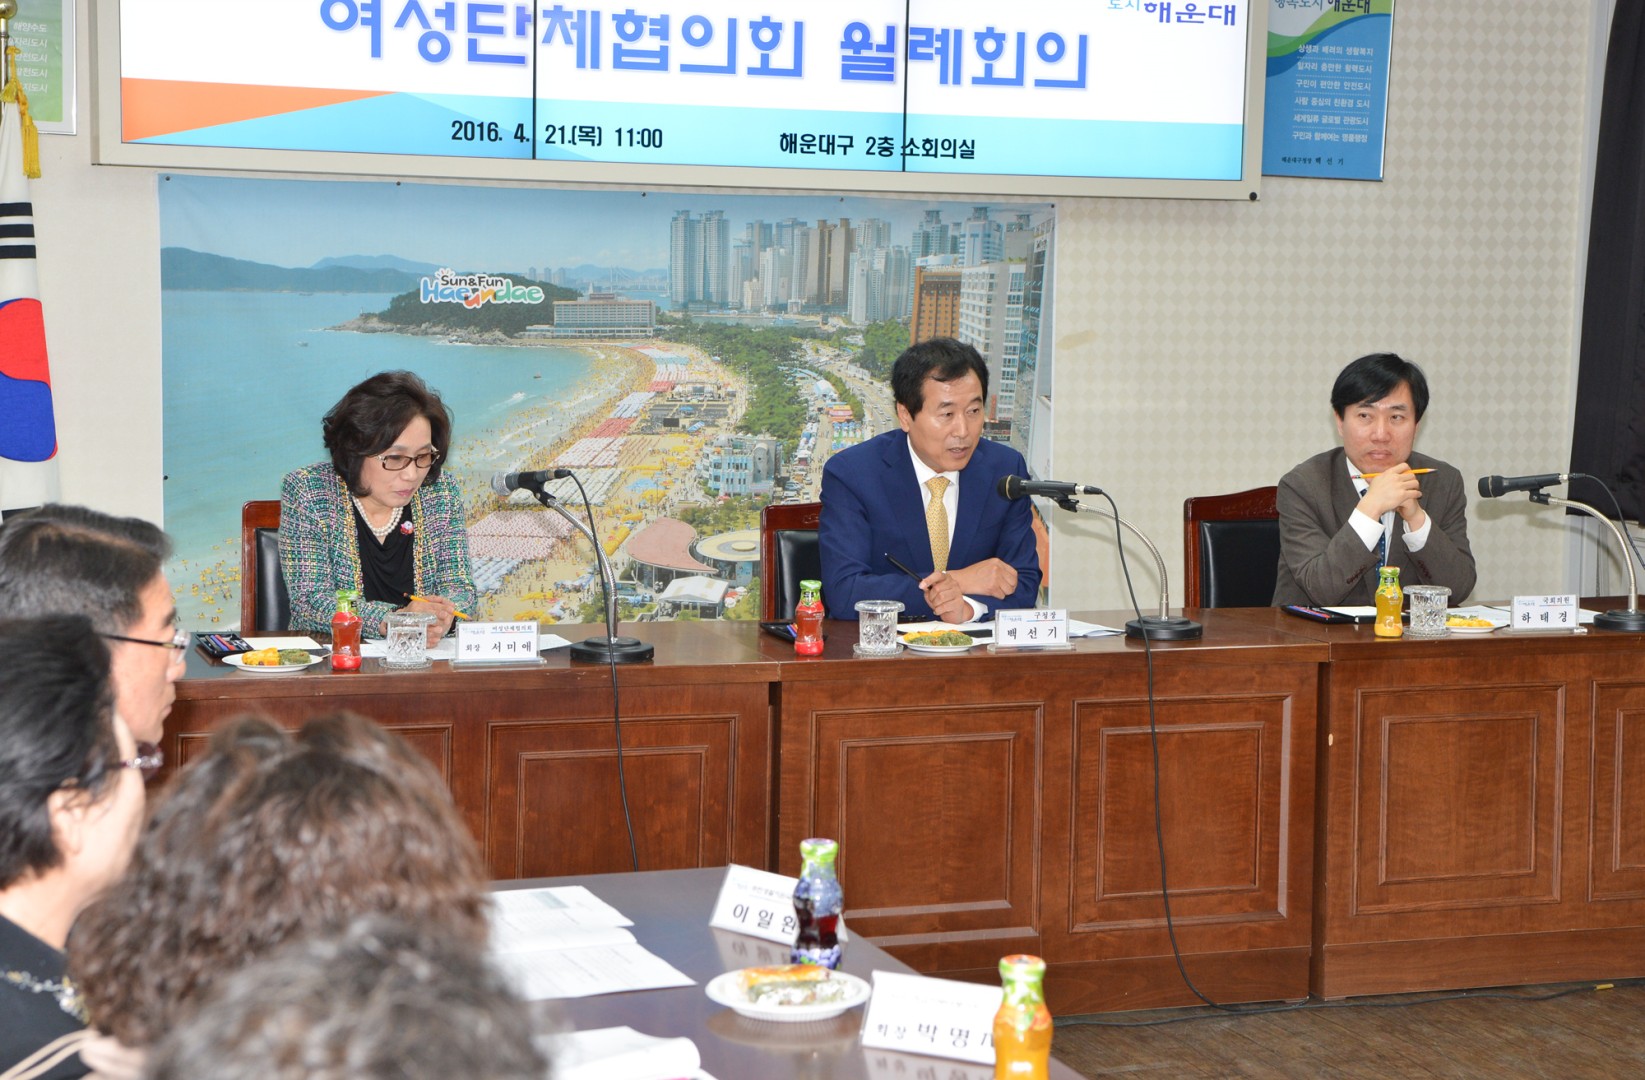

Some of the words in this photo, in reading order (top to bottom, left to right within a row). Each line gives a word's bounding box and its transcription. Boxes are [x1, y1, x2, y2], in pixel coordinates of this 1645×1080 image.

[1144, 2, 1236, 26] 해운대
[13, 21, 48, 33] 해양수도
[320, 0, 804, 78] 여성단체협의회
[840, 21, 1088, 89] 월례회의
[1297, 61, 1318, 71] 일자리
[1356, 99, 1371, 109] 도시
[451, 120, 502, 142] 2016.
[513, 123, 530, 143] 4.
[615, 127, 663, 148] 11:00
[780, 132, 854, 155] 해운대구
[865, 136, 895, 157] 2층
[900, 137, 975, 159] 소회의실
[441, 274, 504, 287] Sun&Fun
[1034, 611, 1057, 619] 구청장
[465, 644, 481, 653] 회장
